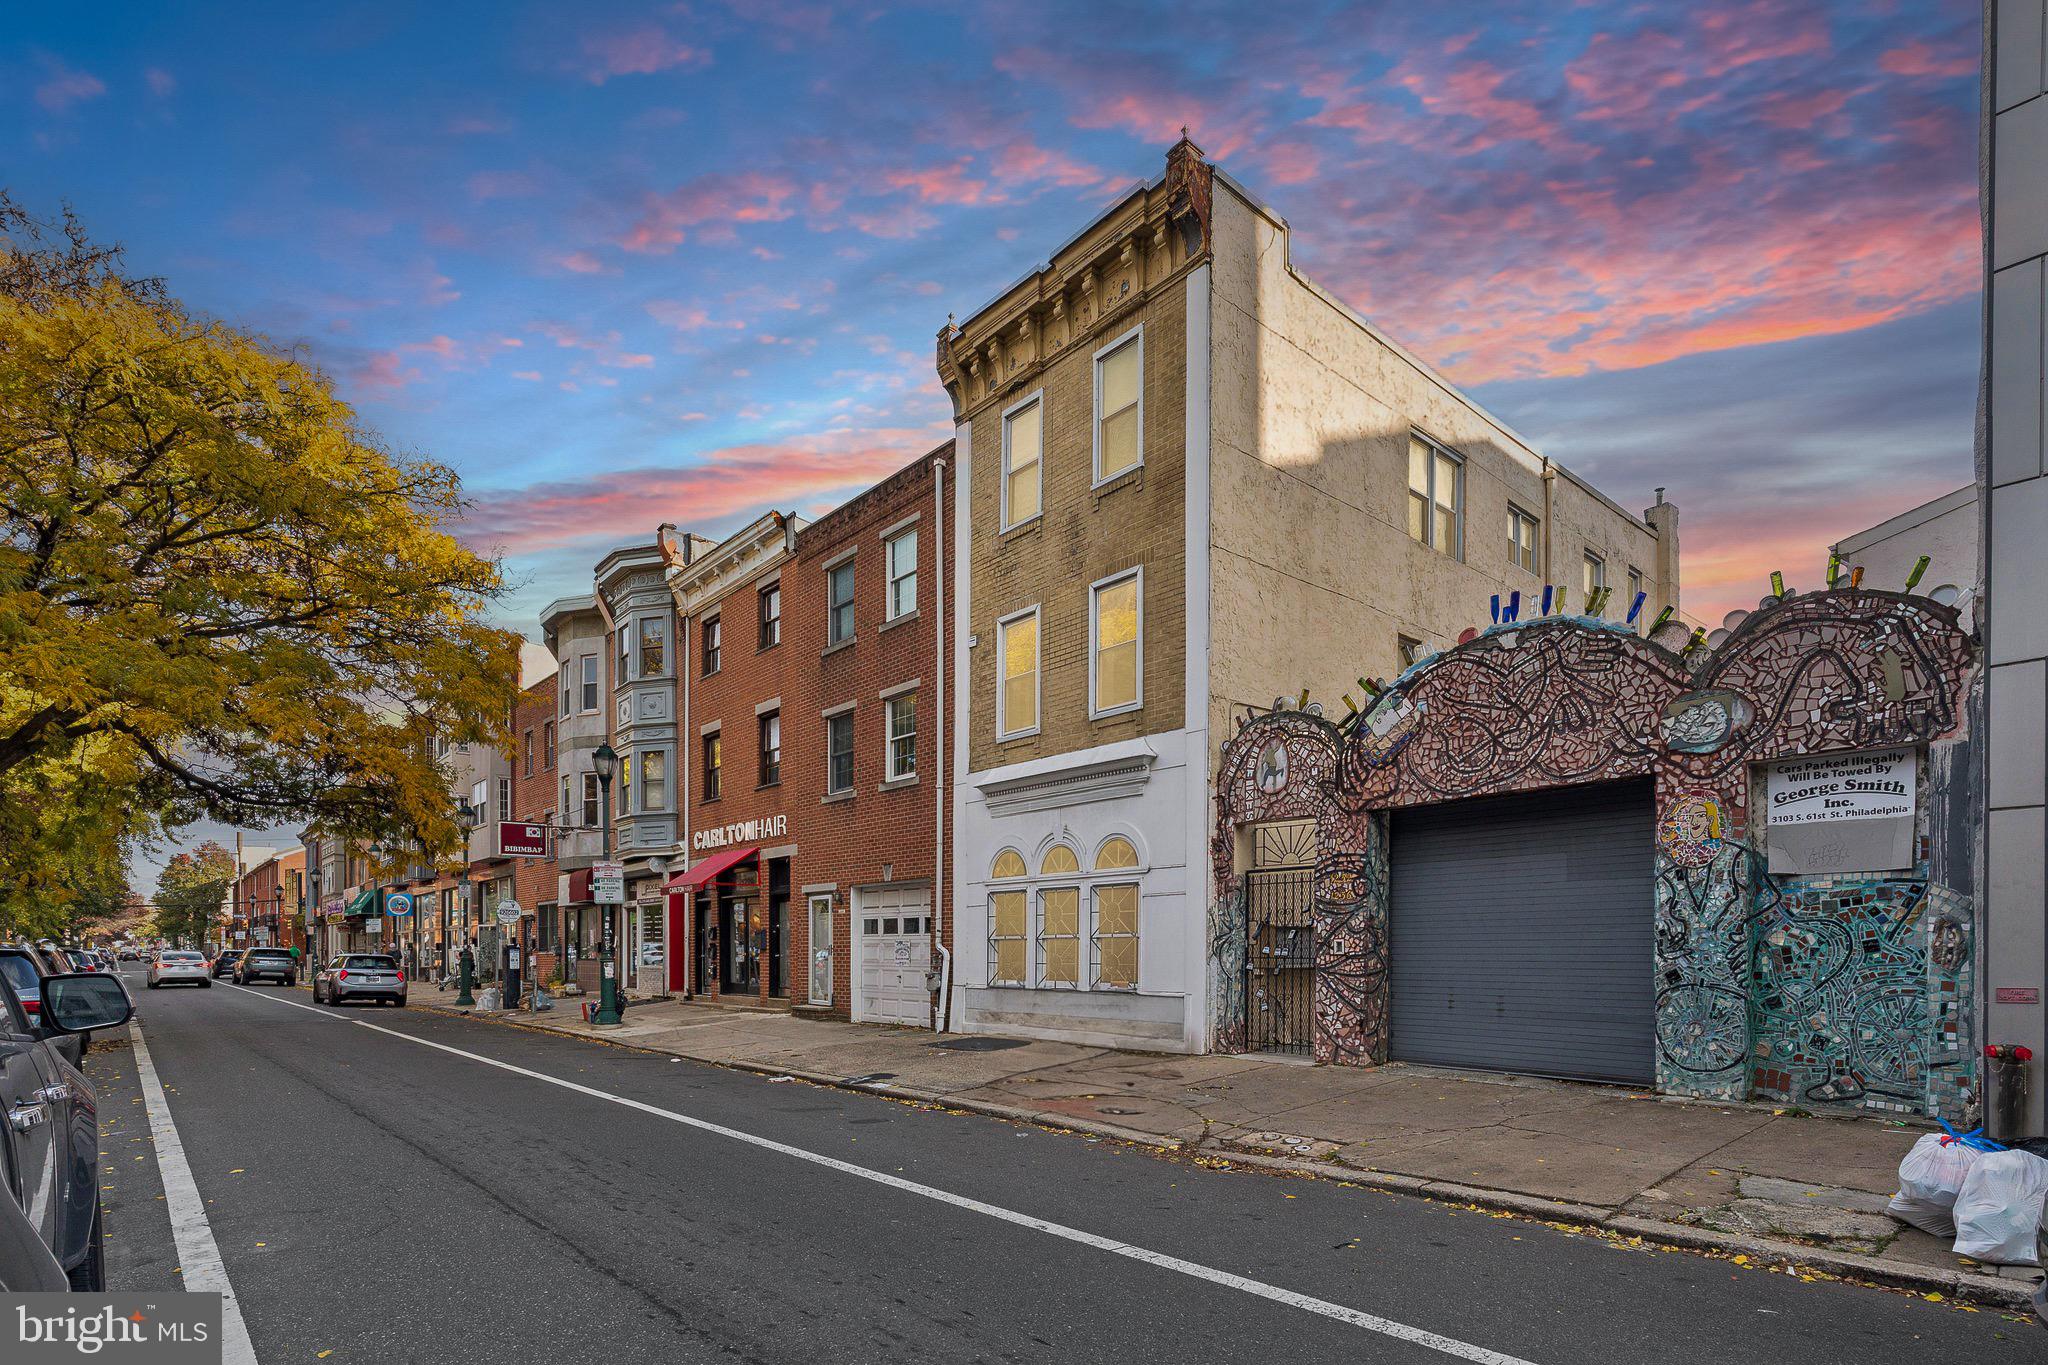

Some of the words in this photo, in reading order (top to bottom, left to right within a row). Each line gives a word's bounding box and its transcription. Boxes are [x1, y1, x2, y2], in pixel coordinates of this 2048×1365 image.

[1777, 765, 1801, 774] Cars
[1805, 758, 1848, 771] Parked
[1851, 752, 1905, 766] Illegally
[1788, 774, 1810, 782] Will
[1813, 770, 1829, 780] Be
[1832, 765, 1872, 778] Towed
[1875, 764, 1892, 775] By
[1774, 782, 1840, 804] George
[1844, 779, 1906, 794] Smith
[1824, 798, 1854, 809] Inc.
[1772, 814, 1794, 823] 3103
[1796, 813, 1804, 821] S.
[1806, 812, 1826, 820] 61st
[1830, 811, 1843, 819] St.
[1845, 805, 1908, 817] Philadelphia
[504, 845, 543, 853] BIBIMBAP
